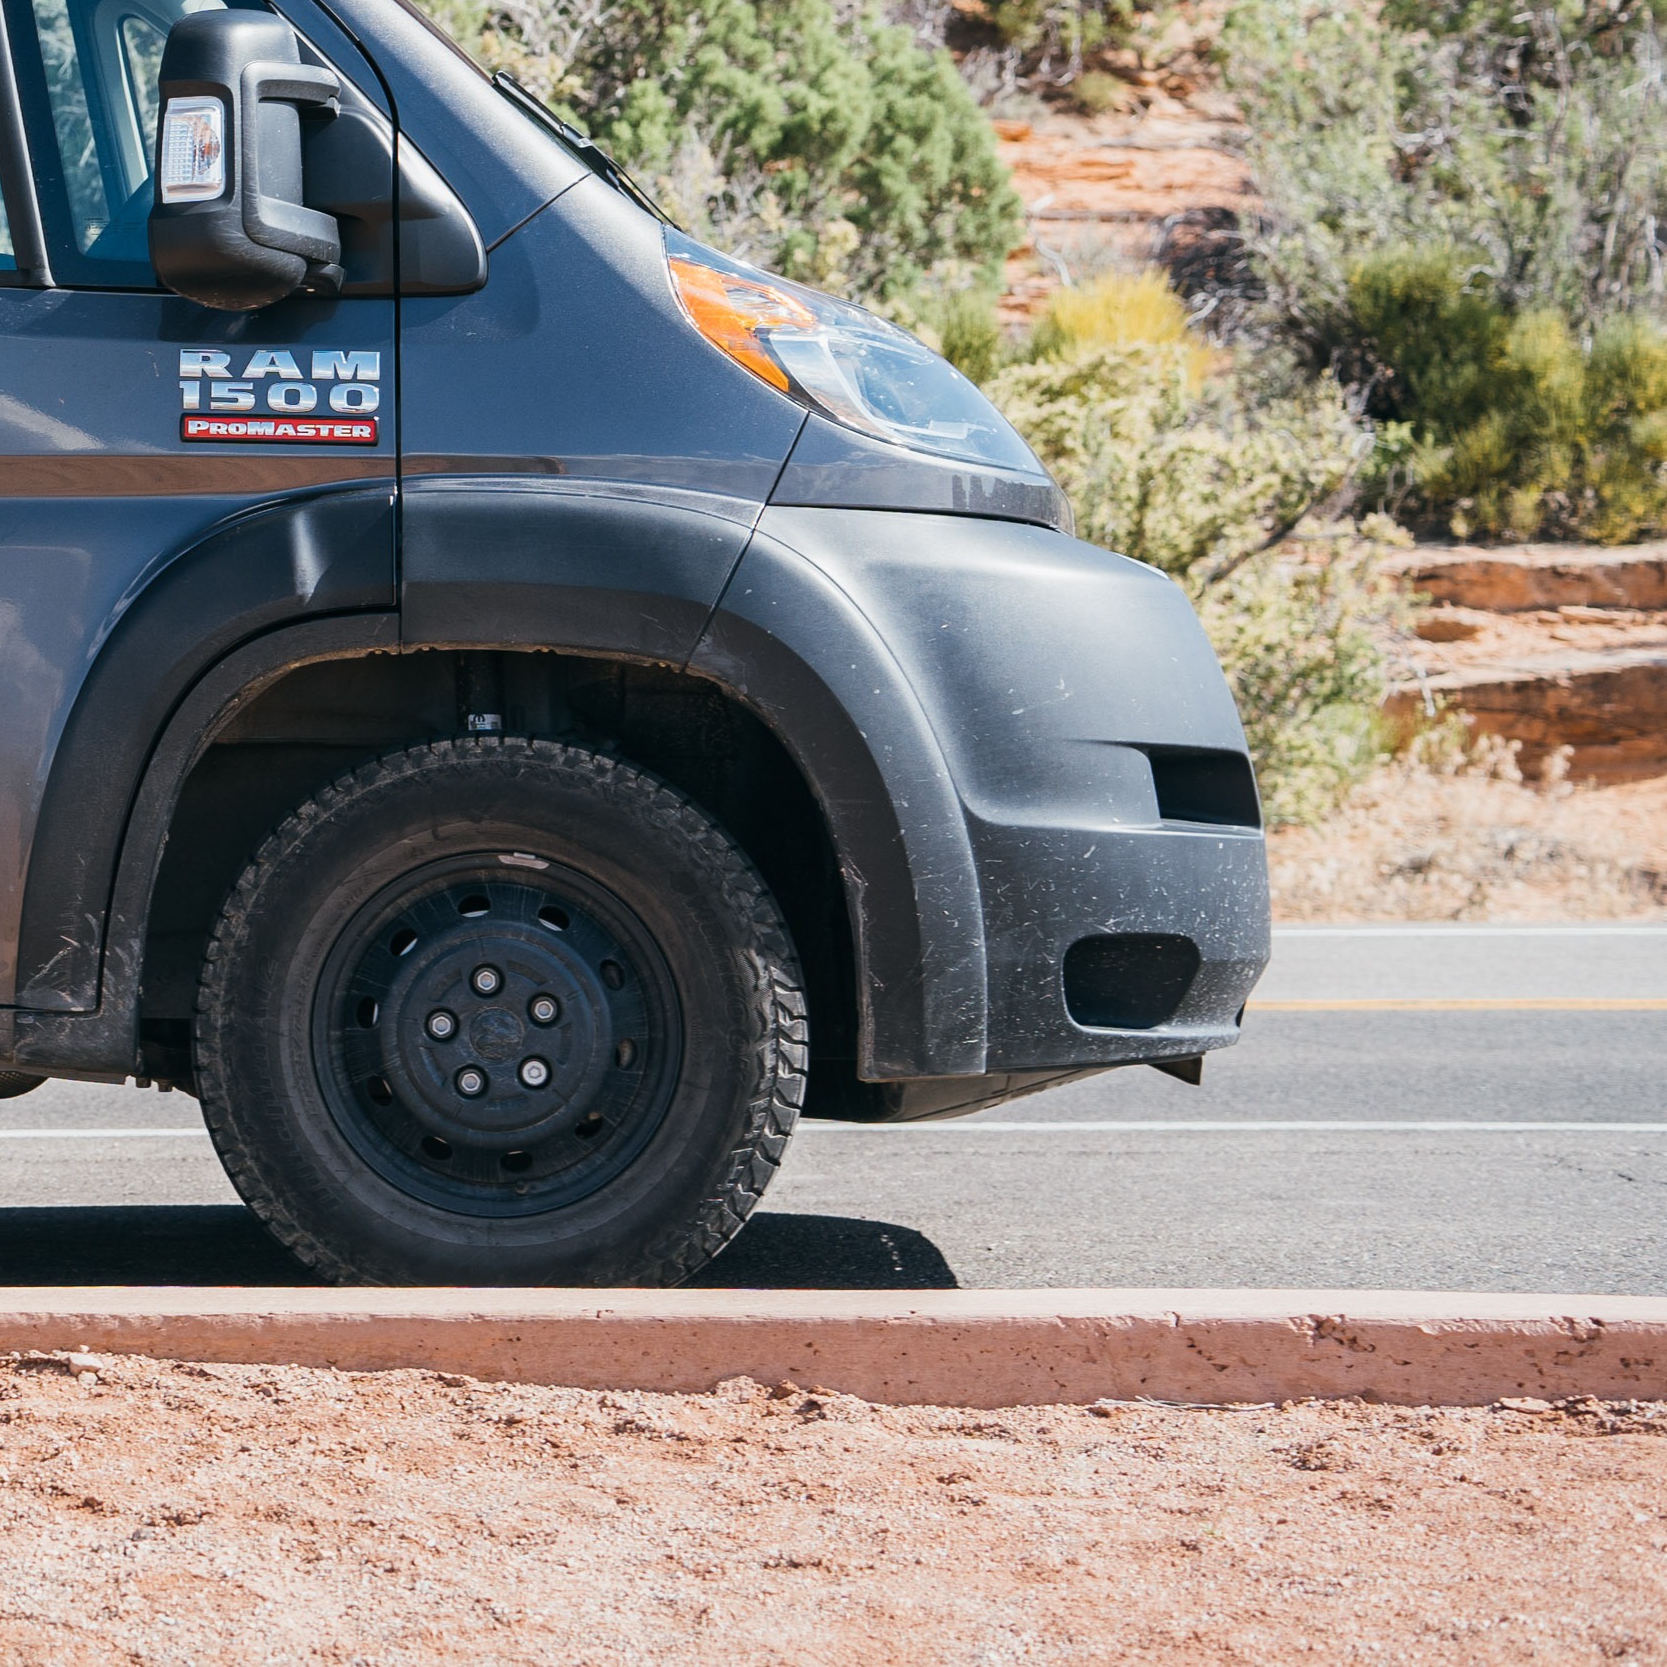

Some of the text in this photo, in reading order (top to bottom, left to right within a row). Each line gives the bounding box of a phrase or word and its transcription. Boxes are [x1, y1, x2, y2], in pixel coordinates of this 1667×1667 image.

[179, 349, 381, 381] RAM
[179, 381, 381, 414] 1500
[187, 419, 372, 439] PROMASTER
